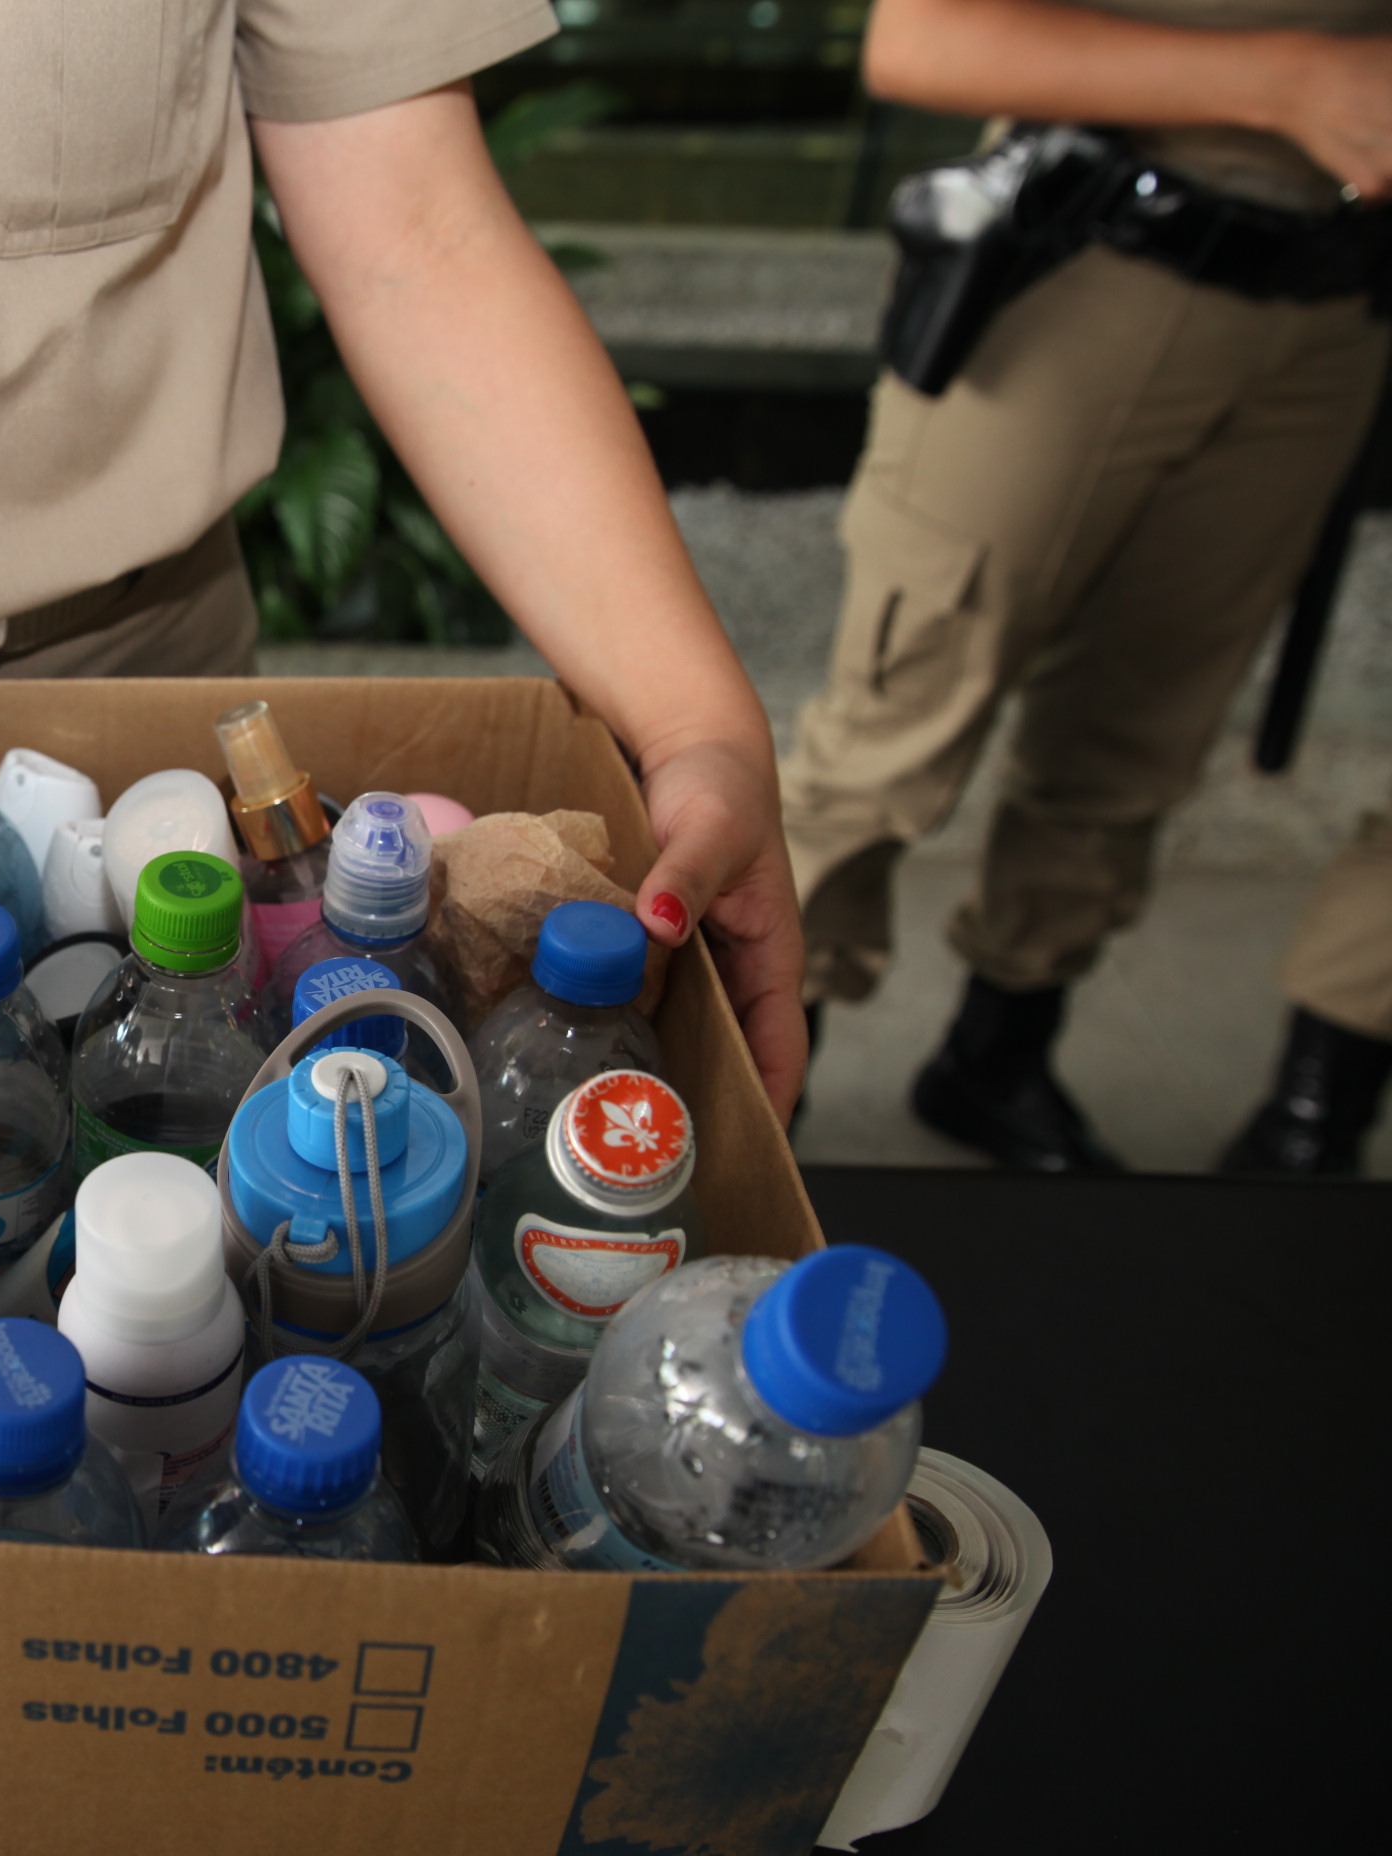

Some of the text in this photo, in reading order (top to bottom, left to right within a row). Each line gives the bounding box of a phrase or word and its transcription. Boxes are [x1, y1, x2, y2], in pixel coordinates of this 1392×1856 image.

[309, 964, 367, 988] RITA
[620, 1119, 685, 1177] PANNA
[528, 1232, 589, 1248] RISERVA
[271, 1363, 330, 1440] SANTA
[306, 1382, 355, 1437] RITA
[22, 1638, 340, 1683] 4800 Folhas
[21, 1699, 331, 1740] 5000 Folhas
[204, 1753, 414, 1784] Contém:
